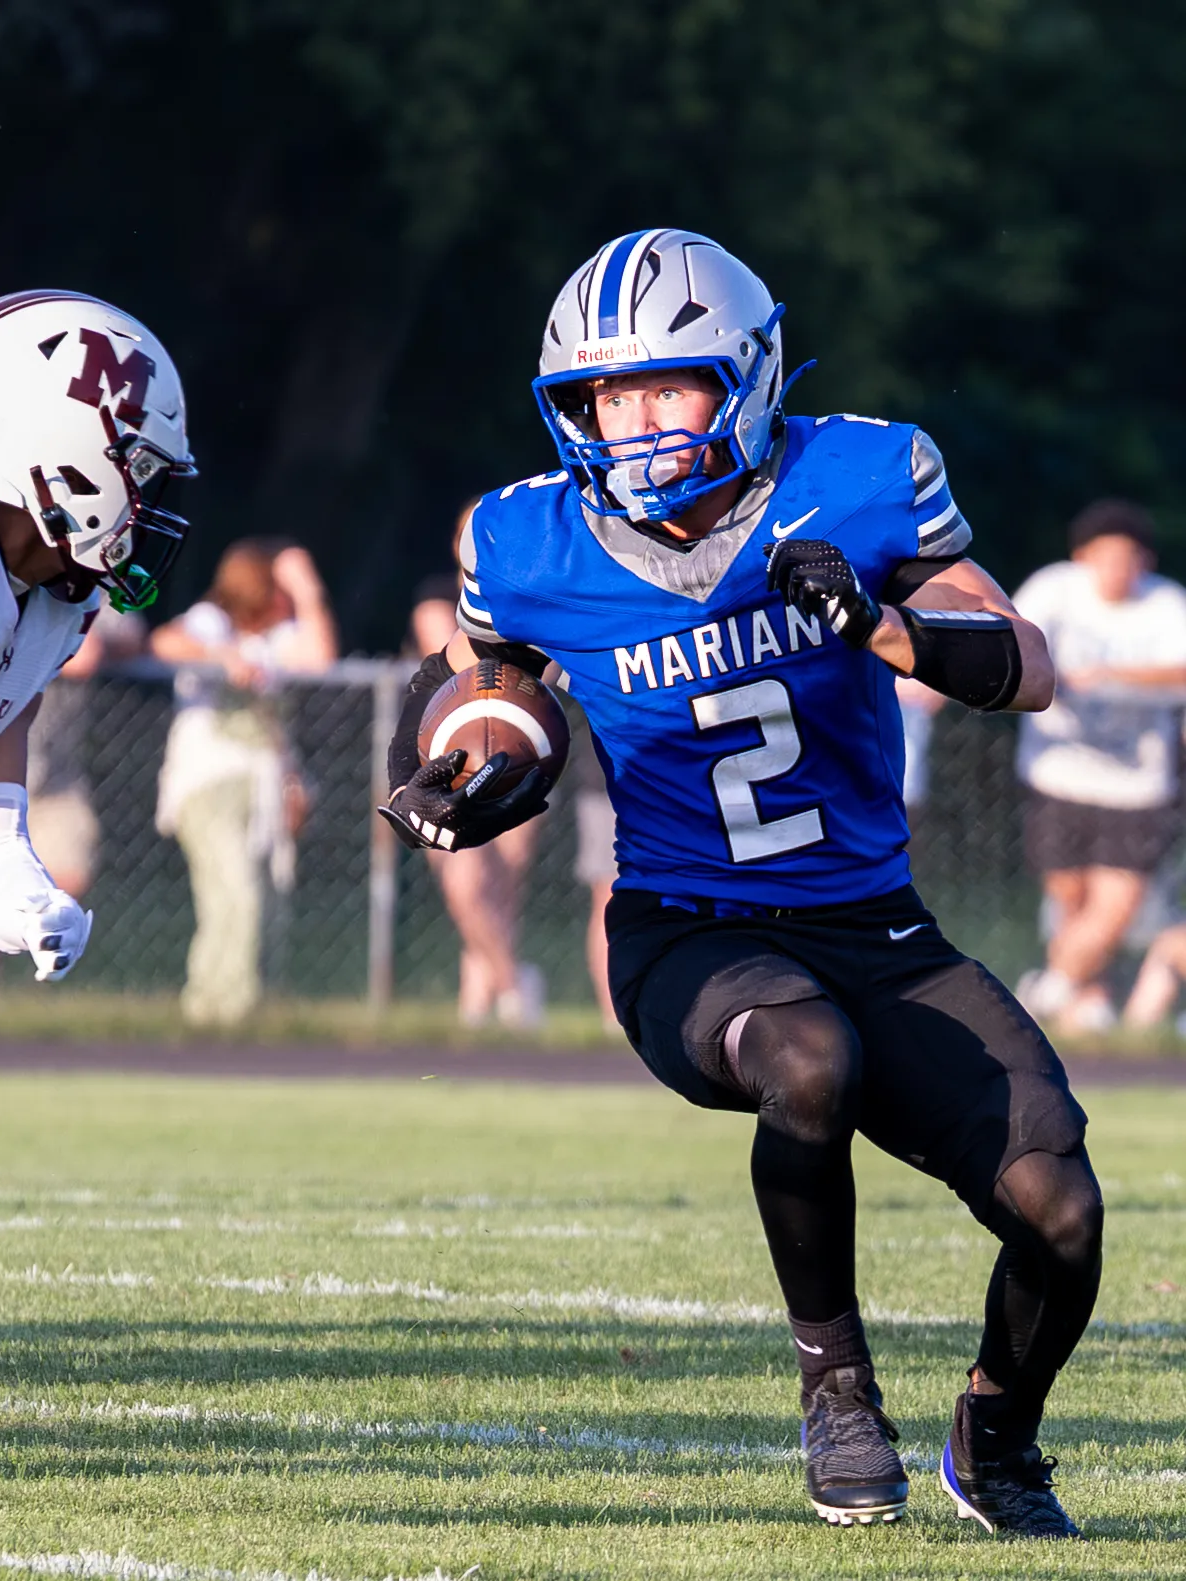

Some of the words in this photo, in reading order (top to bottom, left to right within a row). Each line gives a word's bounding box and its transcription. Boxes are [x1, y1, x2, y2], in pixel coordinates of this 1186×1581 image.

[66, 327, 157, 433] M
[613, 603, 823, 695] MARIAN
[465, 763, 495, 798] ADIZERO
[690, 677, 826, 864] 2
